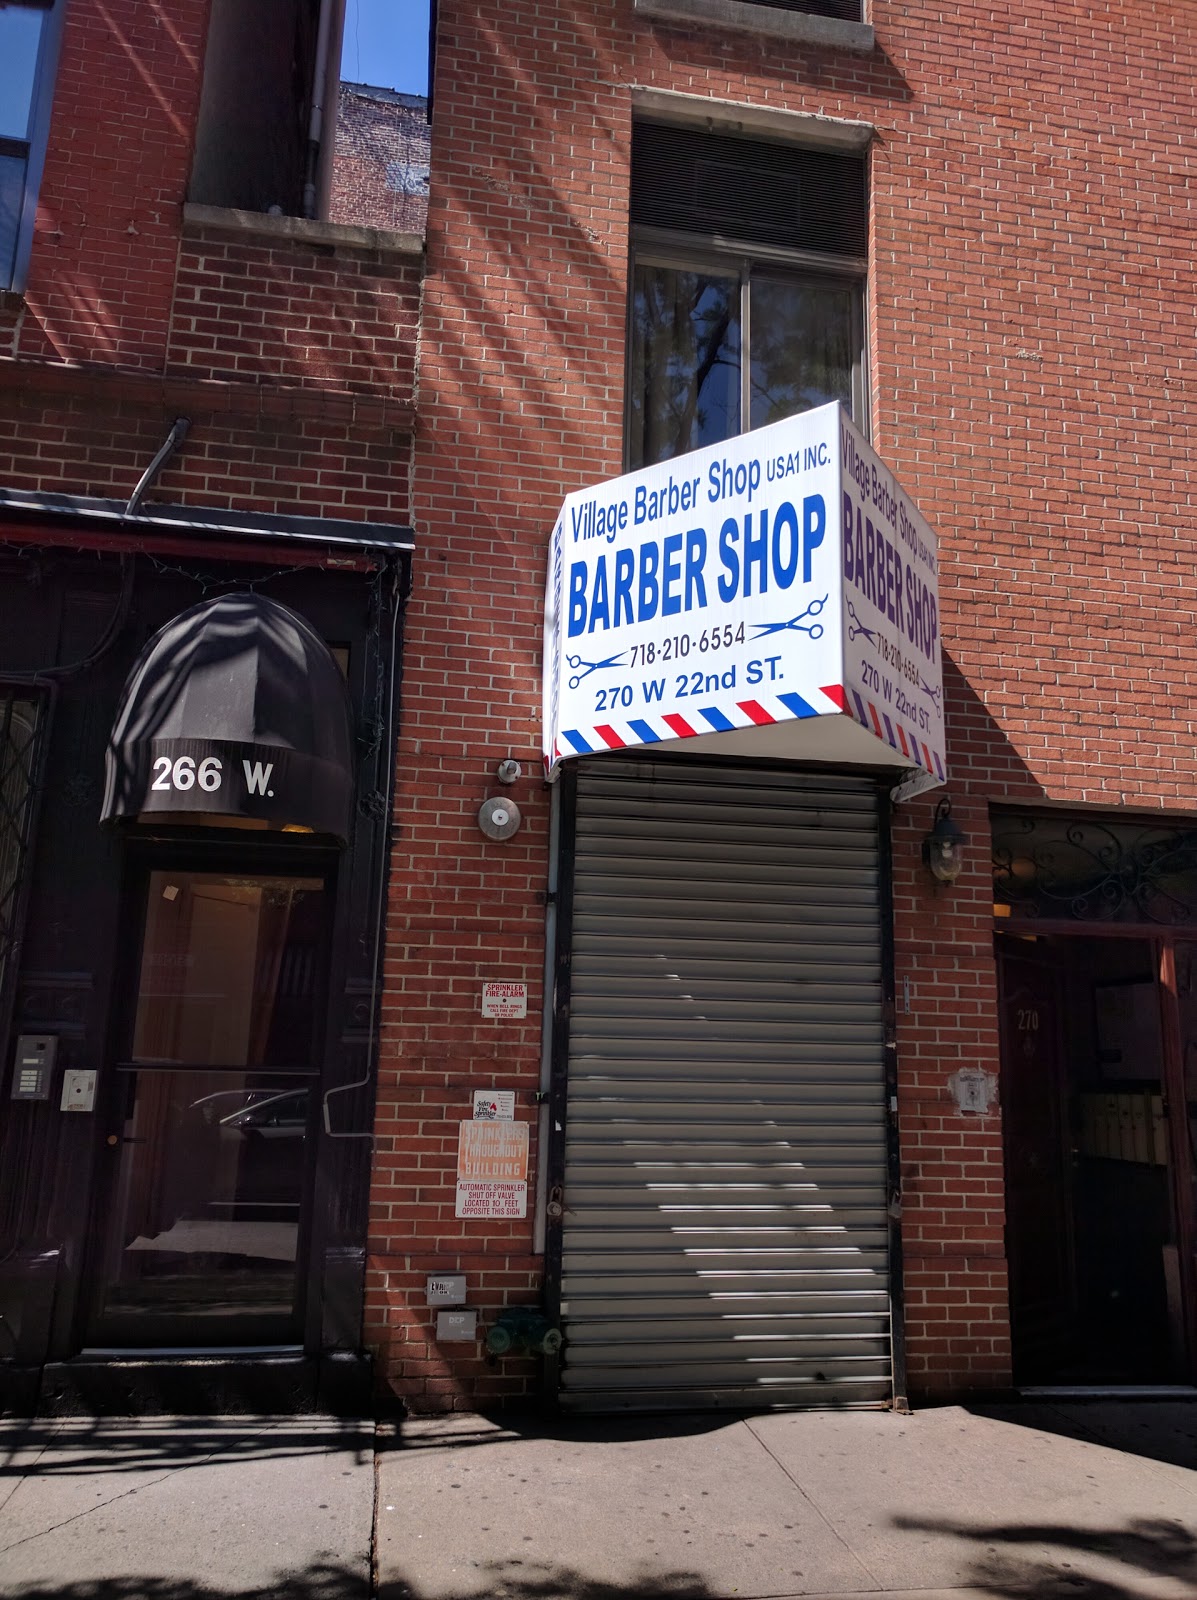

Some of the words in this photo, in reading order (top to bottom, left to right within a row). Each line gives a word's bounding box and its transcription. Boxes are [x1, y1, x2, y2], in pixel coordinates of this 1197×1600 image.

[571, 500, 628, 543] Village
[633, 476, 700, 526] Barber
[707, 458, 761, 503] Shop
[766, 453, 800, 482] USA1
[804, 442, 831, 471] INC.
[841, 423, 870, 502] Village
[871, 463, 898, 531] Barber
[899, 500, 918, 563] Shop
[567, 527, 707, 638] BARBER
[717, 493, 826, 604] SHOP
[843, 489, 904, 634] BARBER
[906, 563, 937, 664] SHOP
[594, 685, 633, 712] 270
[642, 678, 666, 704] W
[675, 664, 736, 698] 22nd
[746, 655, 784, 684] ST.
[861, 659, 879, 694] 270
[882, 675, 893, 704] W
[895, 687, 917, 724] 22nd
[918, 708, 931, 735] ST.
[151, 755, 223, 792] 266
[242, 759, 274, 797] W.
[1018, 1009, 1039, 1030] 270
[459, 1183, 492, 1191] AUTOMATIC
[465, 1161, 521, 1176] BUILDING
[461, 1207, 490, 1215] OPPOSITE
[464, 1199, 490, 1207] LOCATED
[468, 1191, 484, 1199] SHUT
